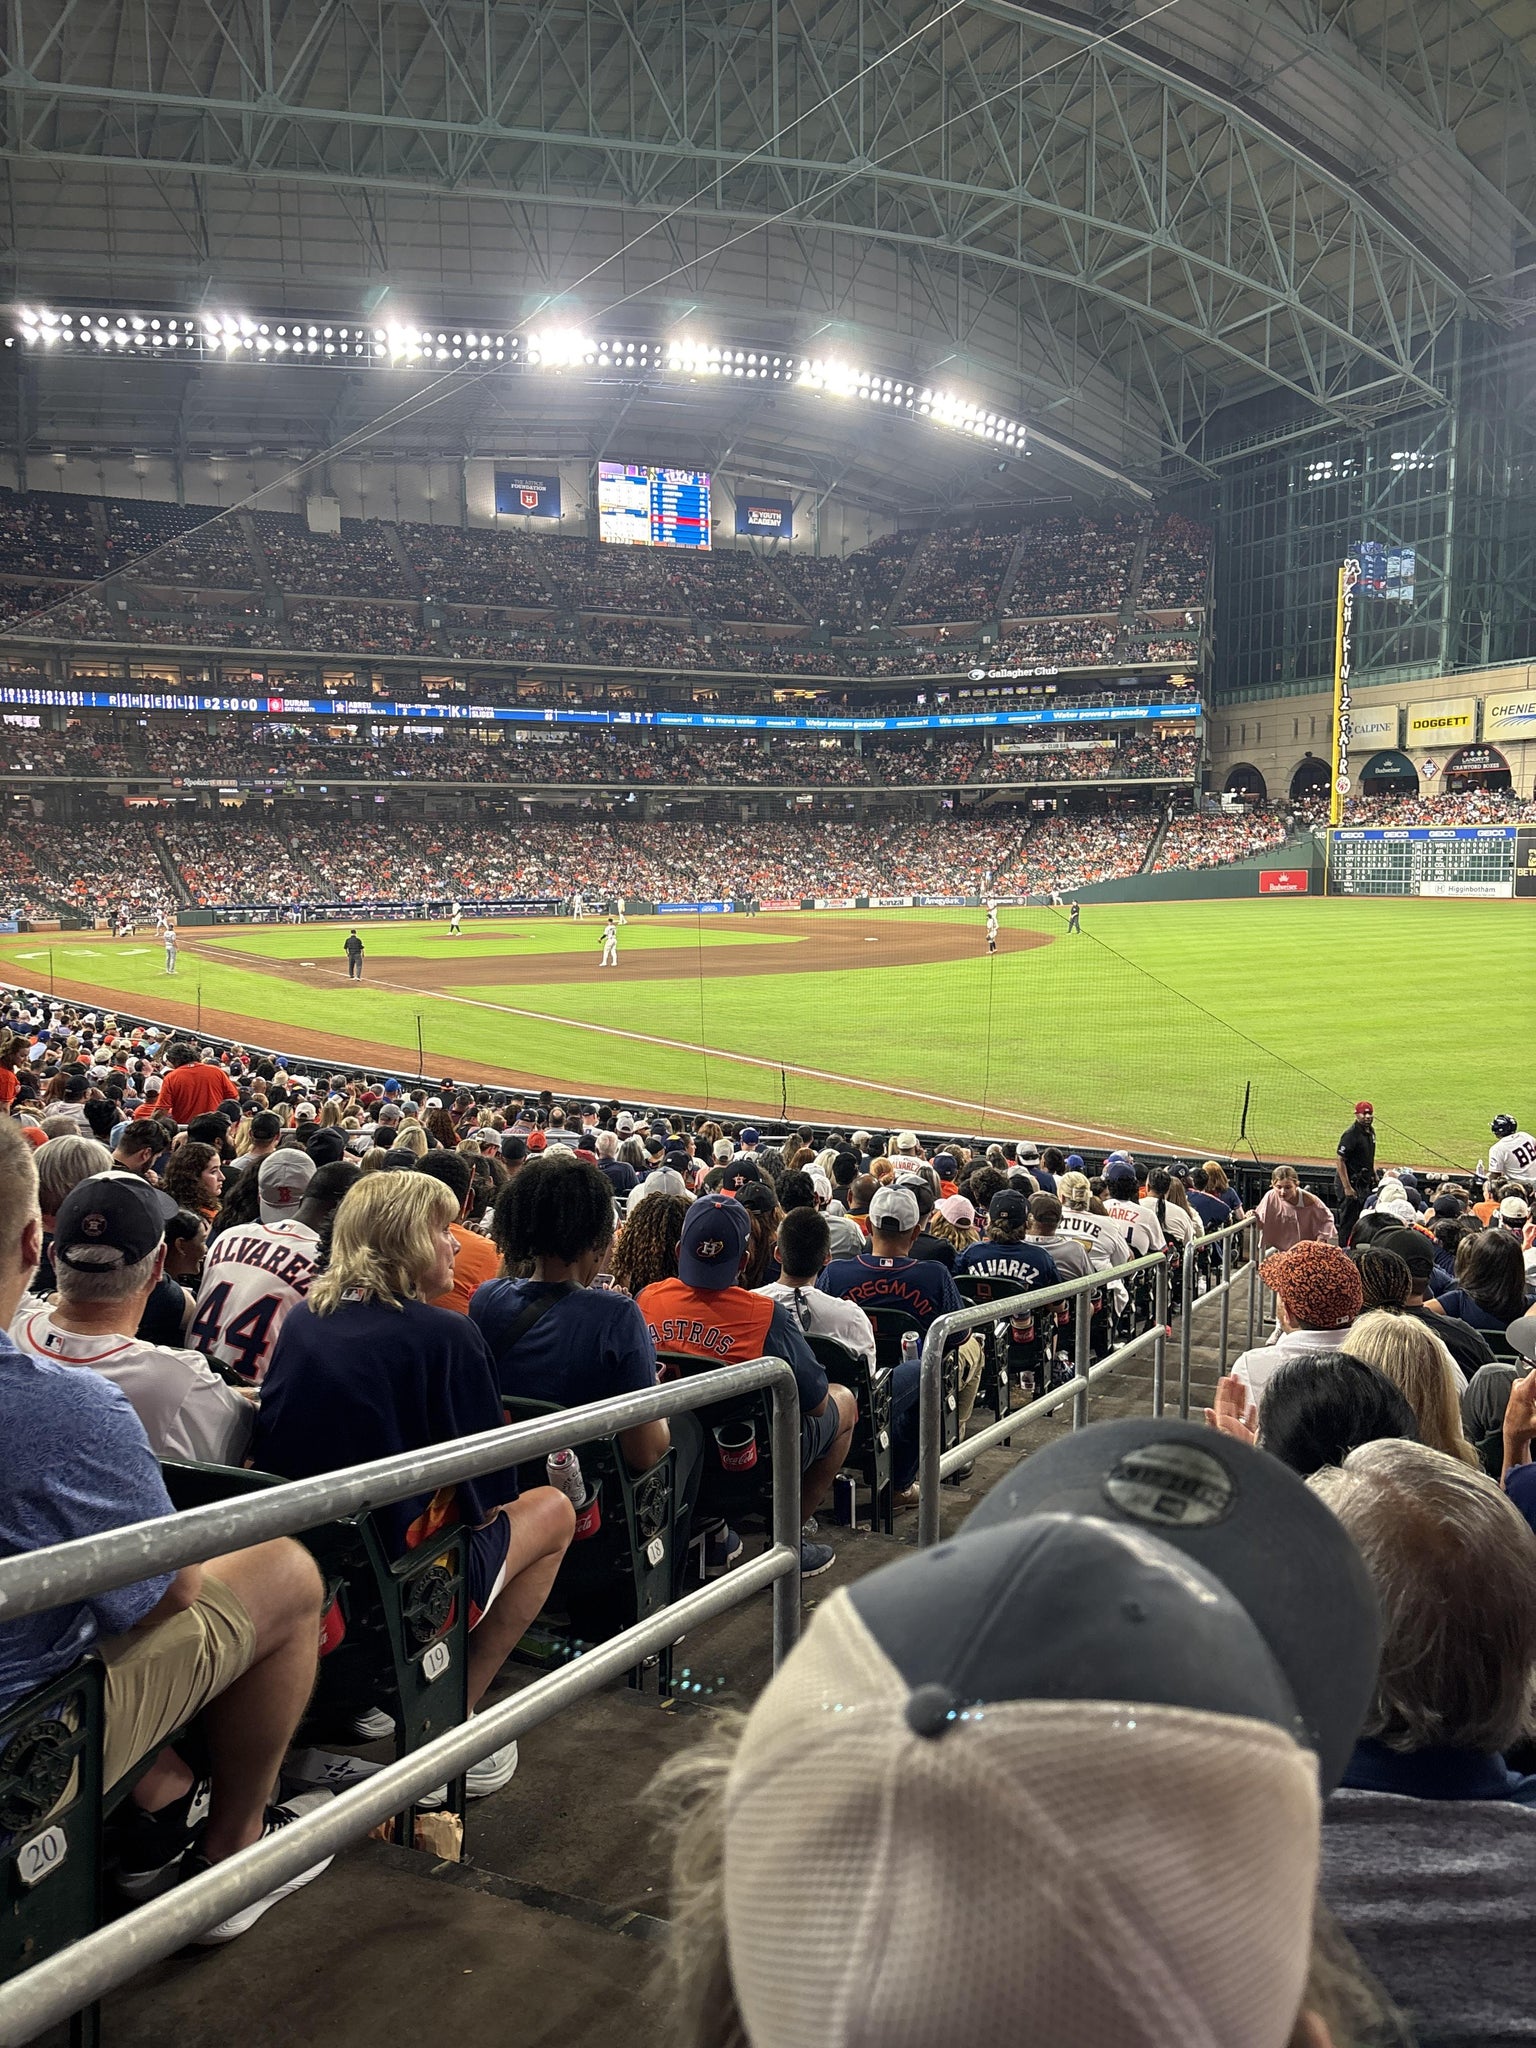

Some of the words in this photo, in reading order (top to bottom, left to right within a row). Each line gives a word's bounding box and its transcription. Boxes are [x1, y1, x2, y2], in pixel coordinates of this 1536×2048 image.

[511, 483, 547, 491] FOUNDATION
[525, 495, 534, 504] H
[759, 511, 782, 519] YOUTH
[748, 517, 782, 527] ACADEMY
[1340, 593, 1354, 679] CHIKIN
[988, 669, 1033, 679] Gallagher
[1034, 665, 1058, 675] Club
[132, 697, 139, 705] H
[155, 697, 162, 706] E
[178, 698, 184, 707] L
[1339, 683, 1352, 710] IZ
[211, 698, 220, 710] 2
[230, 698, 239, 710] 0
[249, 699, 257, 711] 0
[1491, 702, 1536, 717] CHENIE
[451, 706, 460, 718] K
[1053, 710, 1078, 719] Water
[1079, 710, 1109, 720] powers
[1111, 708, 1149, 718] gameday
[702, 716, 715, 724] We
[736, 717, 757, 725] water
[805, 719, 827, 727] Water
[828, 720, 853, 728] powers
[854, 720, 887, 729] gameday
[939, 717, 951, 725] We
[1413, 716, 1468, 729] DOGGETT
[1354, 722, 1391, 735] CALPINE
[1338, 715, 1350, 775] FAIR
[1461, 755, 1490, 763] LANDRY'S
[1375, 766, 1401, 775] Budweiser
[1452, 763, 1482, 771] CRAWFORD
[1314, 831, 1326, 839] 315
[1517, 868, 1536, 877] BET
[1269, 883, 1298, 891] Budweiser
[1448, 885, 1496, 893] Higginbotham
[924, 897, 960, 906] AmegyBank
[1056, 1217, 1102, 1239] TUVE
[968, 1258, 1040, 1285] ALVAREZ
[190, 1280, 283, 1380] 44
[648, 1319, 736, 1356] ASTROS
[722, 1449, 754, 1466] Coca-Cola
[649, 1541, 662, 1561] 18
[428, 1647, 444, 1673] 19
[26, 1834, 58, 1875] 20
